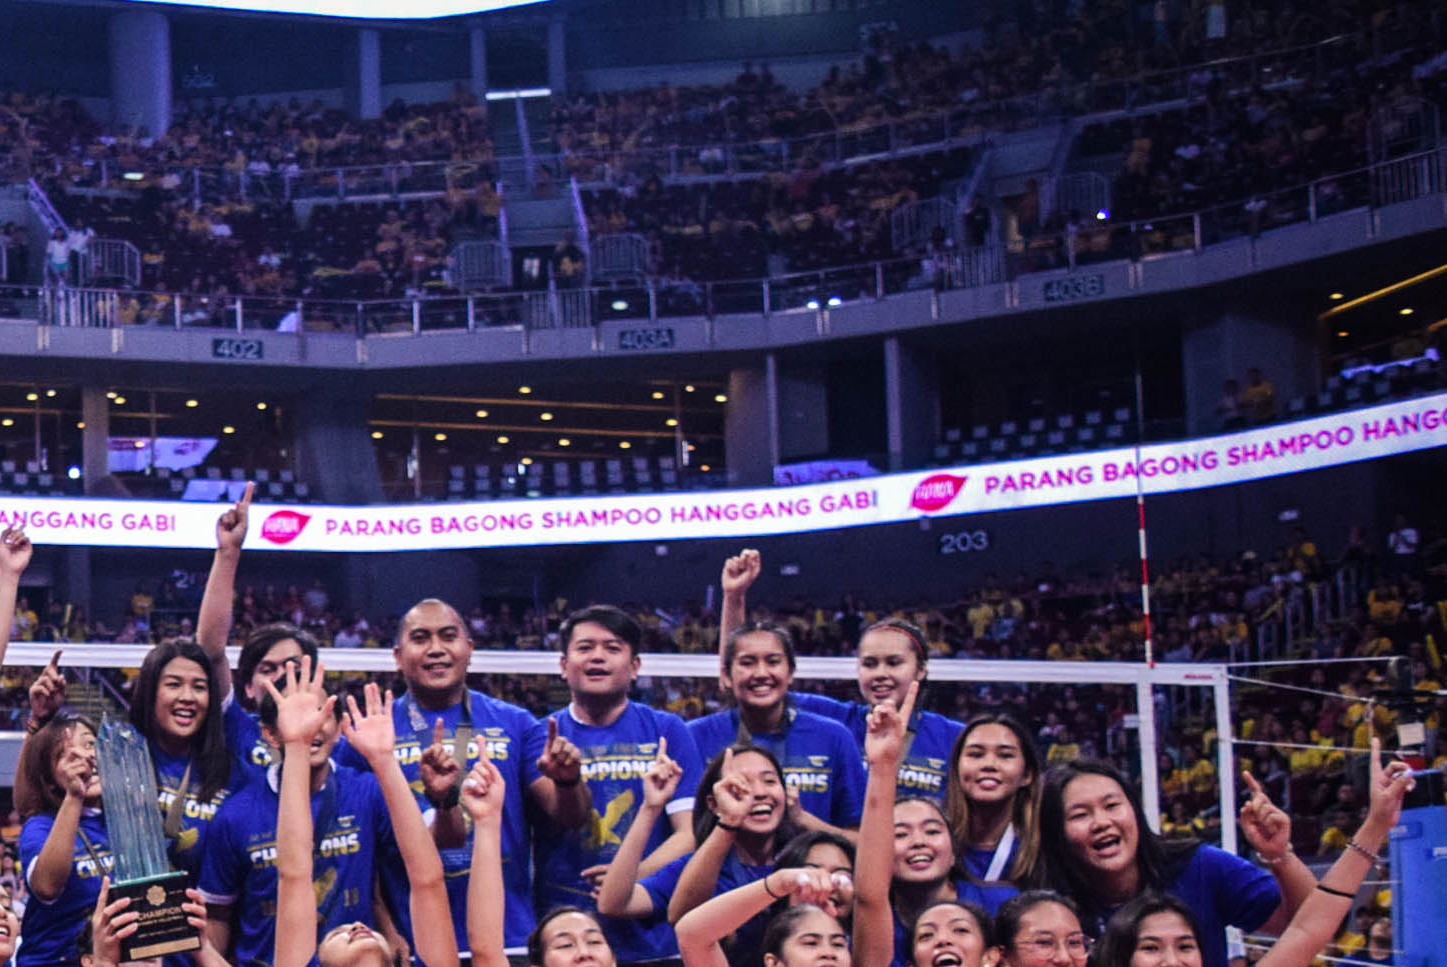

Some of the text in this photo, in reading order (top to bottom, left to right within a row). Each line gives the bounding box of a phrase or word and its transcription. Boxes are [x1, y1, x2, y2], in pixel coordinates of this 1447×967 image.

[216, 340, 259, 358] 402
[985, 465, 1094, 494] PARANG
[1103, 451, 1219, 482] BAGONG
[1227, 426, 1354, 466] SHAMPOO
[121, 513, 176, 532] GABI
[326, 518, 422, 536] PARANG
[430, 513, 533, 534] BAGONG
[542, 507, 662, 529] SHAMPOO
[670, 499, 812, 524] HANGGANG
[819, 489, 878, 512] GABI
[940, 530, 988, 553] 203
